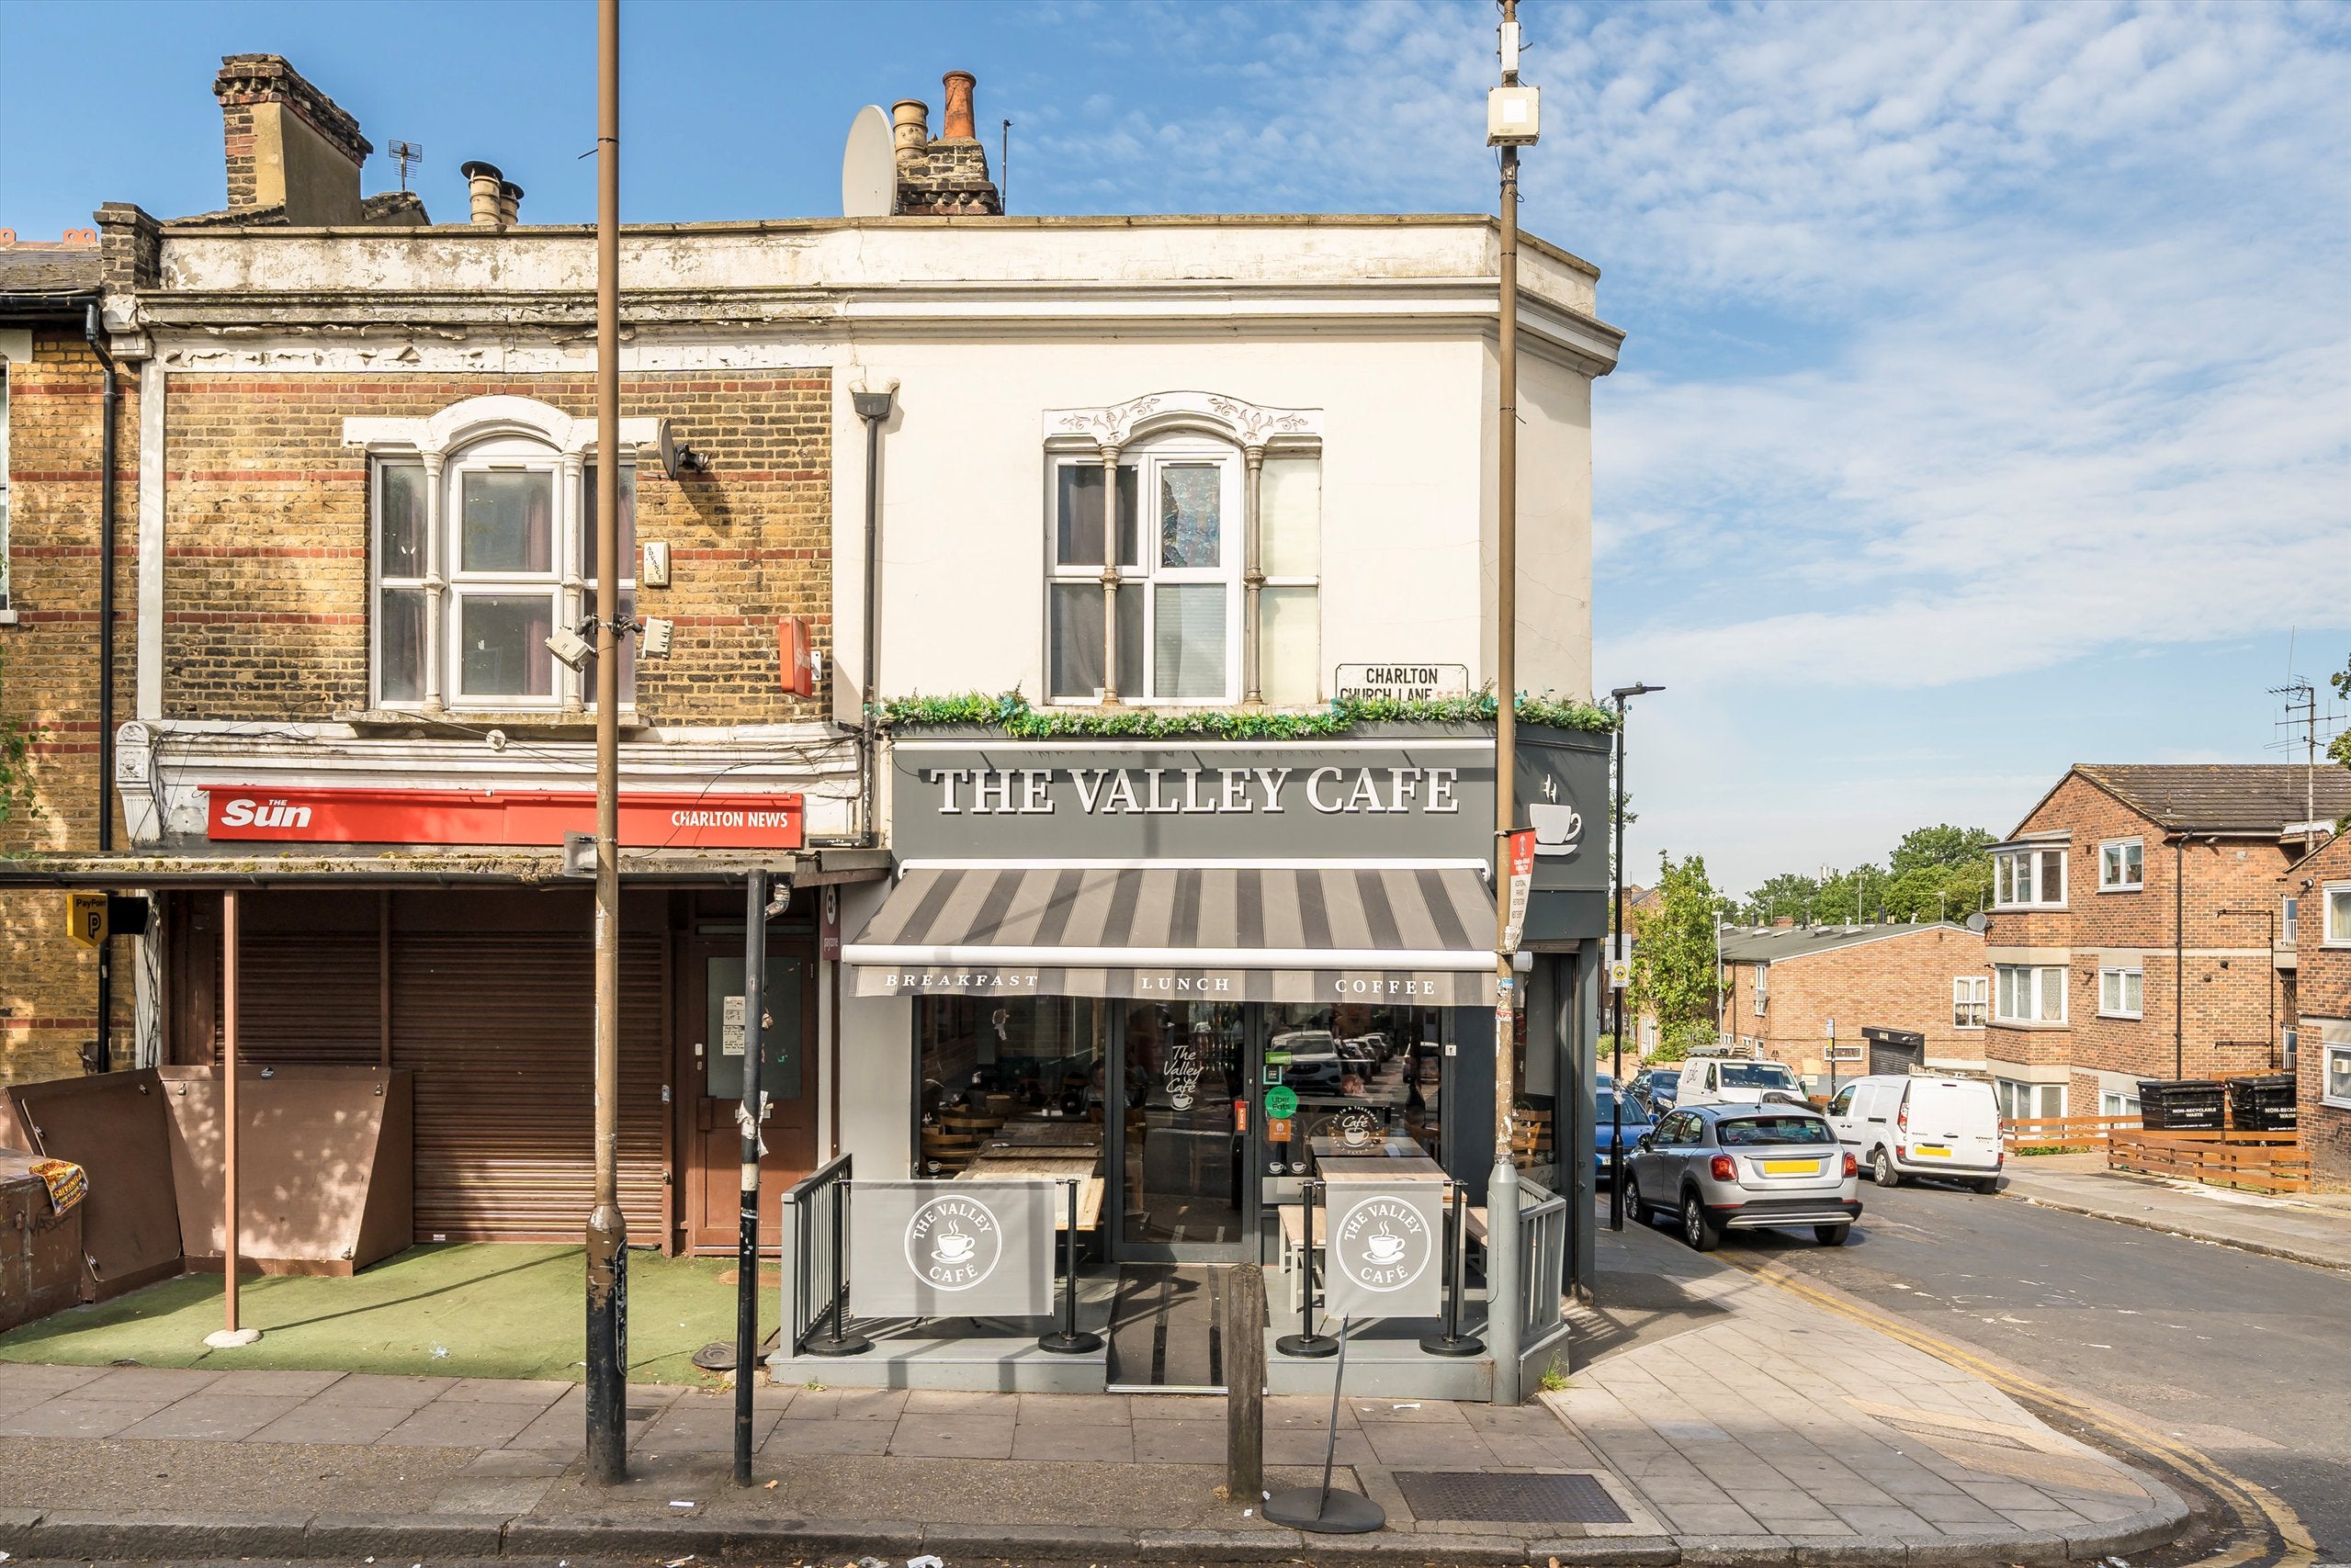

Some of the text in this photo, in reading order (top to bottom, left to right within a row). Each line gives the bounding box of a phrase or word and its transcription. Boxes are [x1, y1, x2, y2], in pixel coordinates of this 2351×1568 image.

[647, 547, 662, 580] ADVANCE
[1366, 668, 1438, 684] CHARLTON
[1340, 688, 1392, 701] CHURCH
[1398, 688, 1432, 702] LANE
[930, 766, 1459, 815] THE VALLEY CAFE
[220, 798, 312, 828] Sun
[671, 810, 788, 828] CHARLTON NEWS
[885, 974, 1038, 987] BREAKFAST
[1141, 977, 1229, 991] LUNCH
[1335, 979, 1435, 995] COFFEE
[1172, 1045, 1197, 1060] The
[1163, 1059, 1204, 1083] Valley
[1341, 1114, 1369, 1132] Café
[54, 1169, 82, 1200] FUNFAIRS
[912, 1202, 992, 1240] THE VALLEY
[1344, 1203, 1422, 1241] THE VALLEY
[929, 1263, 978, 1282] CAFÉ
[1360, 1264, 1408, 1283] CAFÉ
